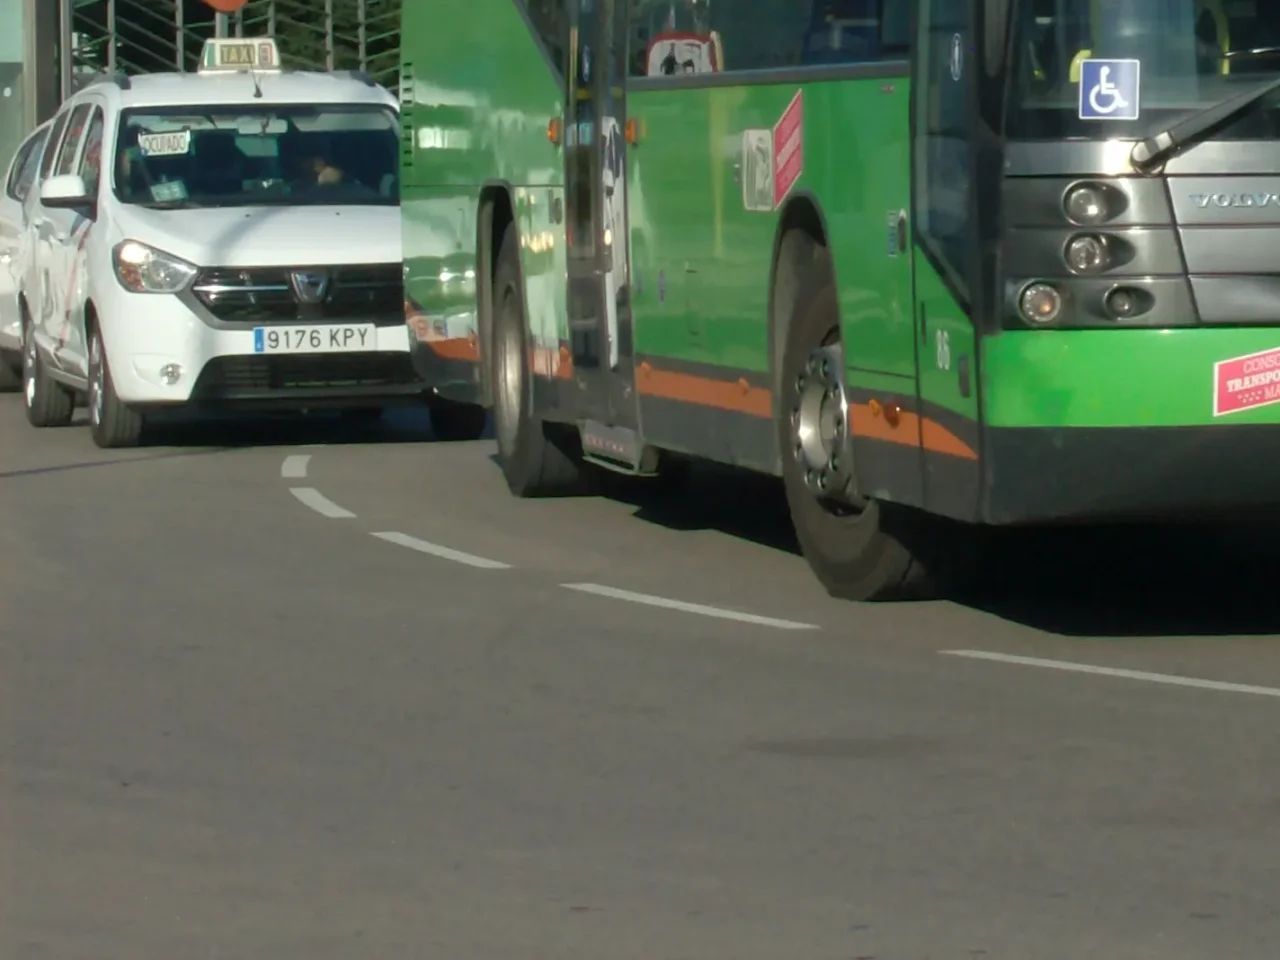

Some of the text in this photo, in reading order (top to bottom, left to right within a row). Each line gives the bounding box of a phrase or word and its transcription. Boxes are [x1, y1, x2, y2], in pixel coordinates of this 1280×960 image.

[220, 44, 256, 64] TAXI
[143, 133, 186, 154] OCUPADO
[267, 328, 369, 349] 9176 KPY
[936, 328, 951, 371] 86
